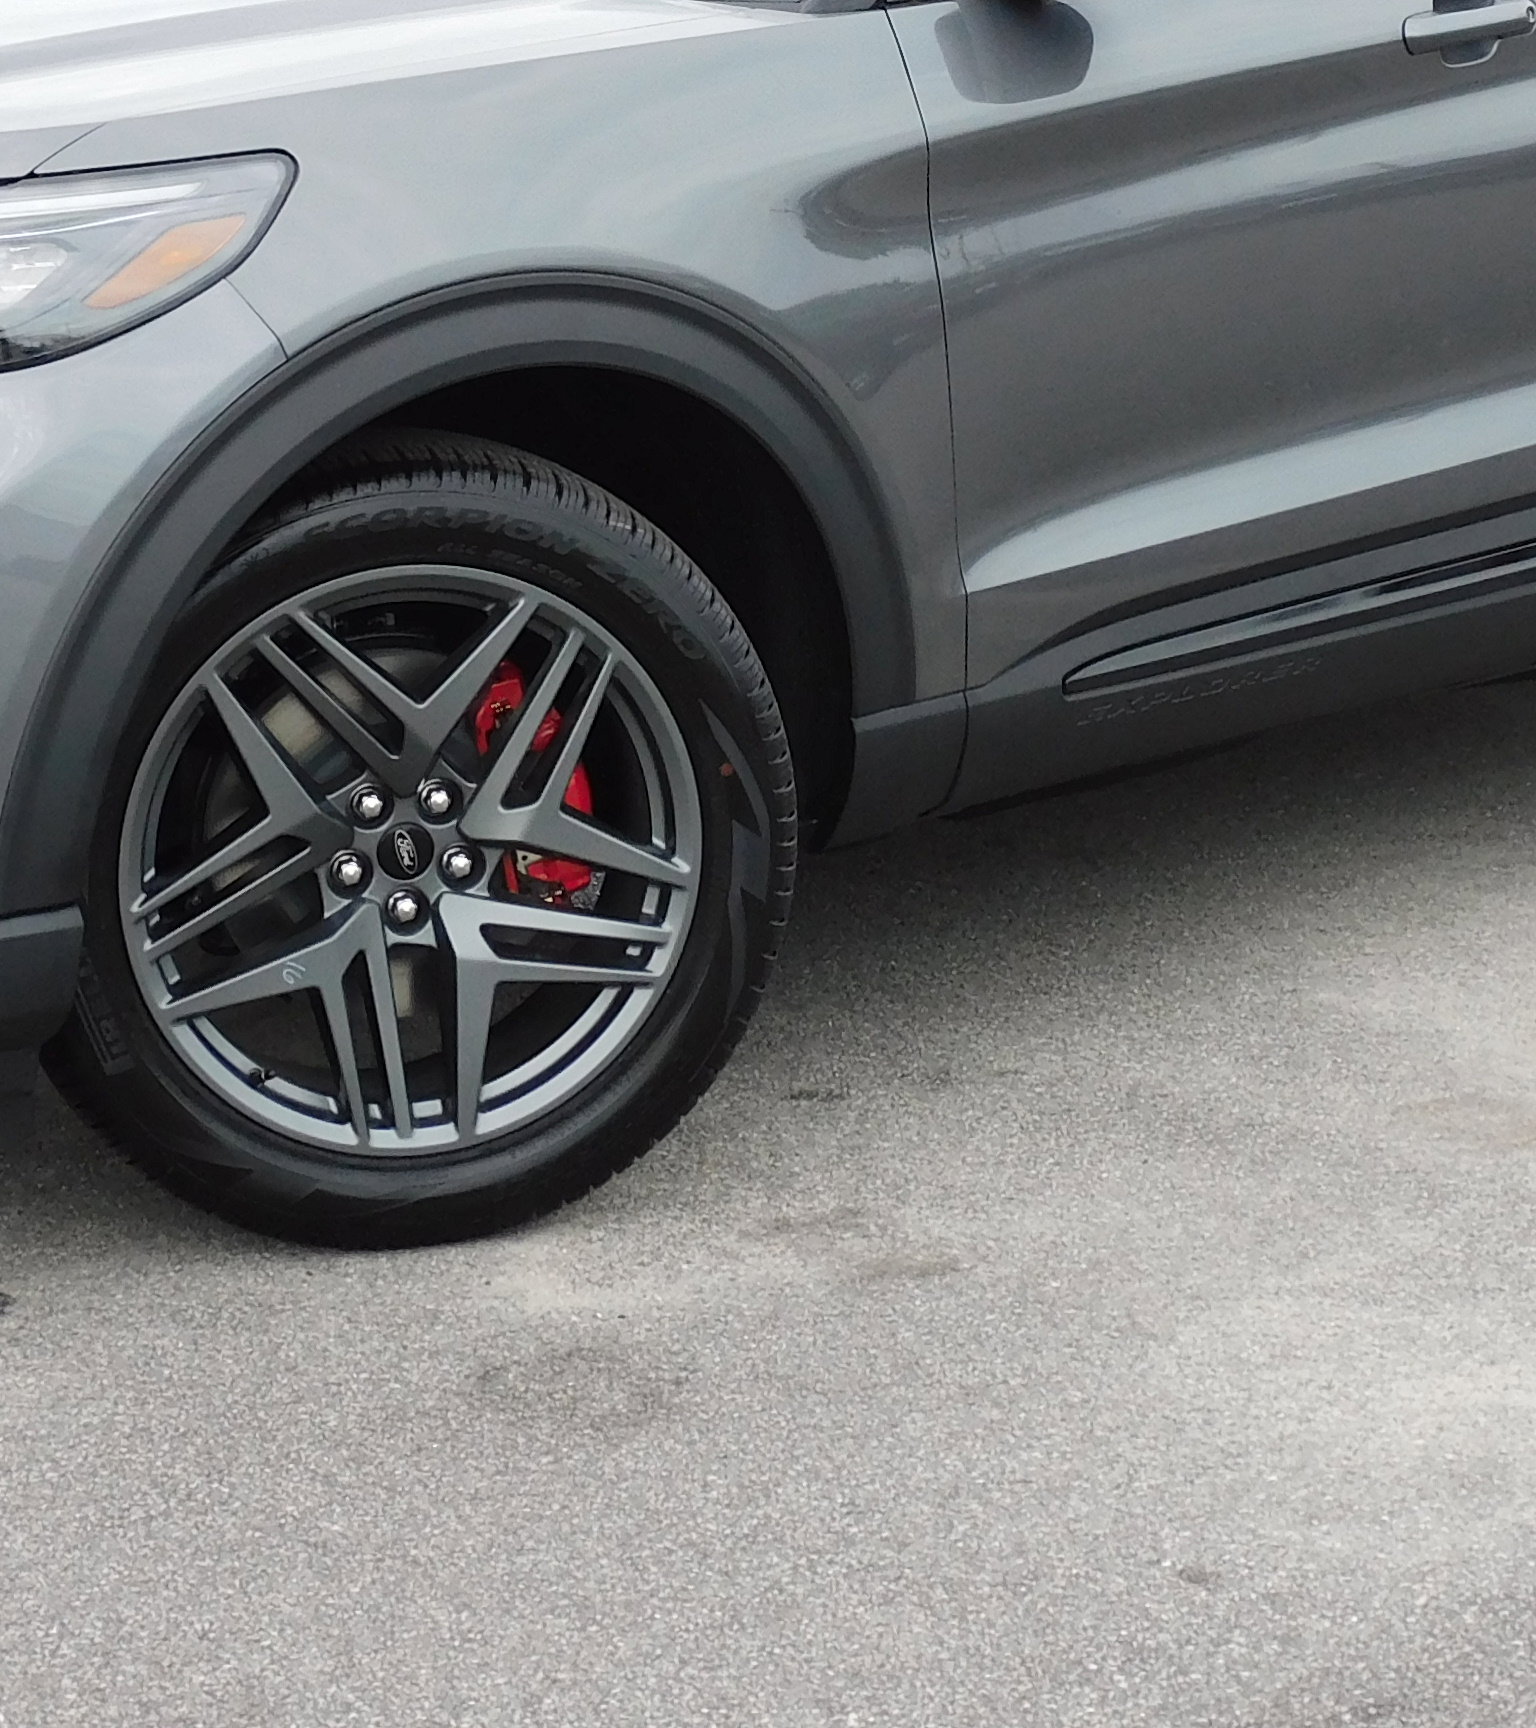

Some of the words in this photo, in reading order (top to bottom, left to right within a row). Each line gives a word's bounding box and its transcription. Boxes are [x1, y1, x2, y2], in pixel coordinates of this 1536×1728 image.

[303, 506, 580, 557] SCORPION
[583, 547, 706, 660] ZERO
[1076, 656, 1322, 726] EXPLORER
